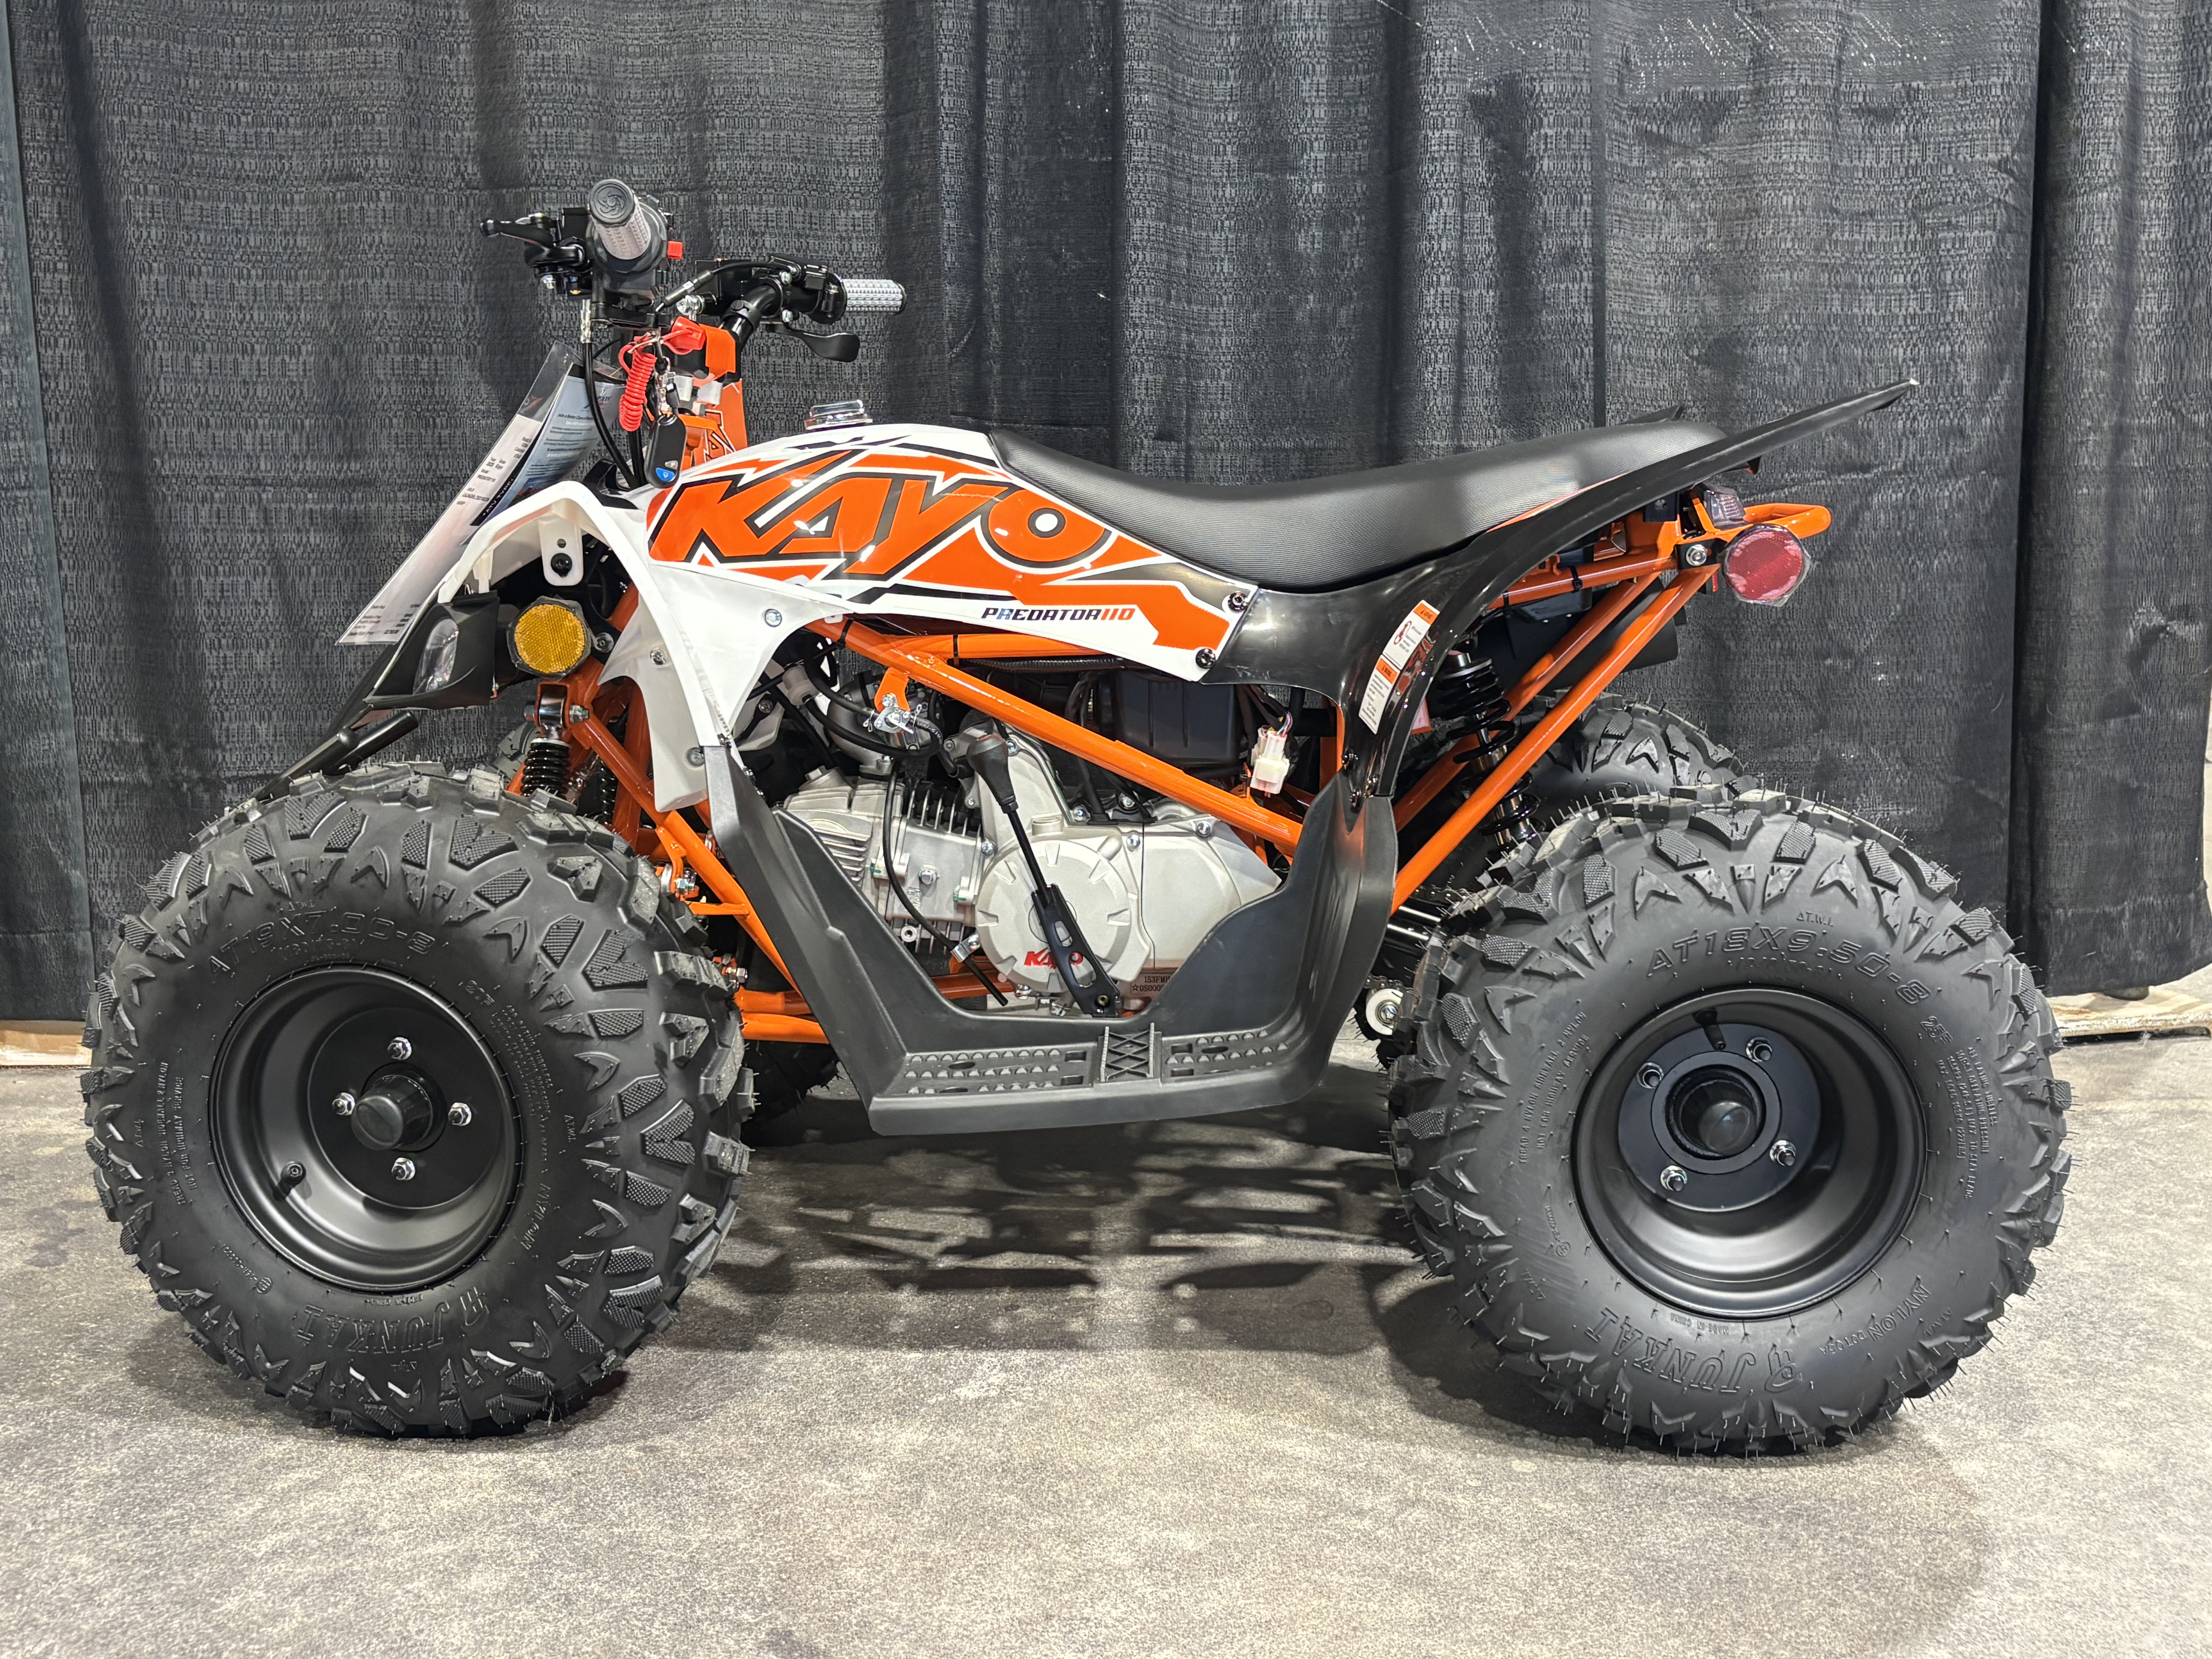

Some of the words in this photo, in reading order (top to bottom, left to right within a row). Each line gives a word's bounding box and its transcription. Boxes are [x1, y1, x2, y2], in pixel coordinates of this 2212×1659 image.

[648, 448, 1113, 581] KAYO
[1024, 947, 1084, 969] KAO
[1635, 925, 1933, 1010] AT18X9.50-8
[1919, 1012, 1955, 1048] 25F
[157, 1060, 169, 1089] NYLON
[1521, 1091, 1539, 1122] NYLON
[1560, 1010, 1588, 1039] NYLON
[158, 1140, 173, 1168] NYLON
[179, 1153, 191, 1171] FOR
[168, 1178, 186, 1206] TREAD
[184, 1173, 198, 1191] NOT
[519, 1183, 552, 1251] NYLON
[294, 1300, 462, 1353] JUNKAI
[1865, 1283, 1933, 1343] NYLON
[1580, 1306, 1758, 1393] JUNKAI
